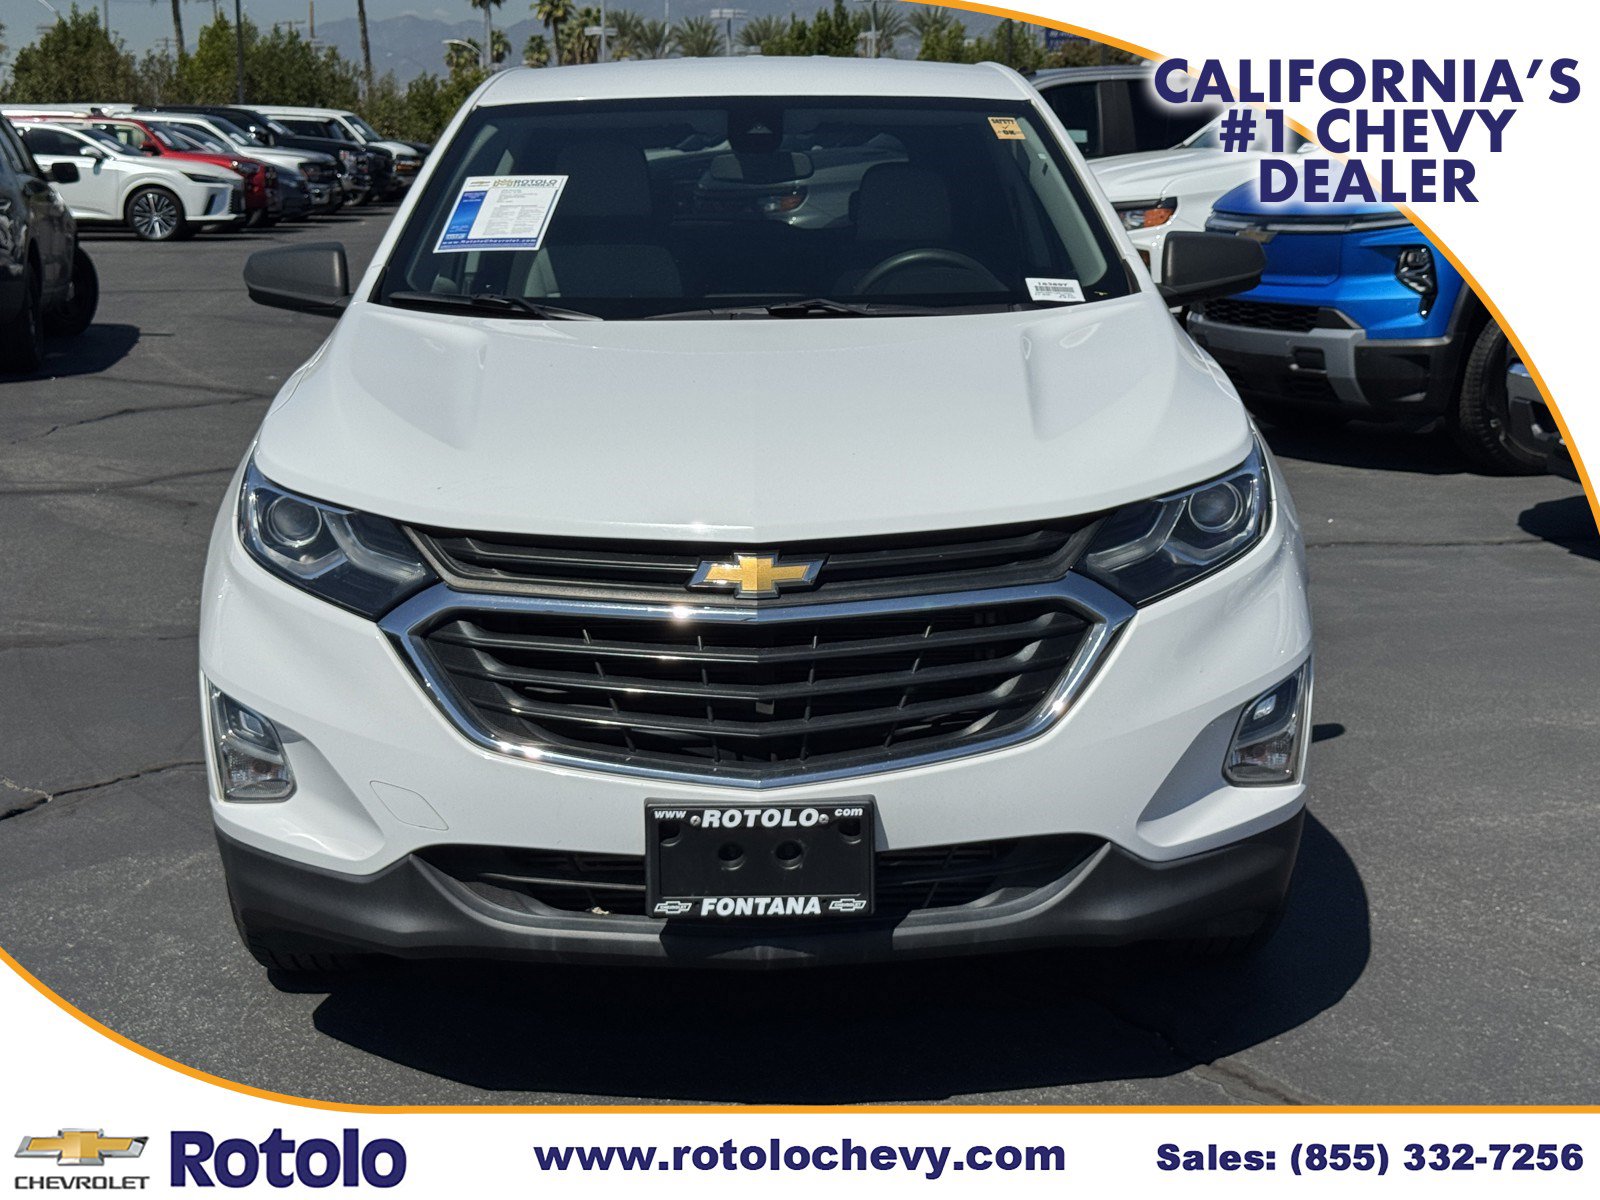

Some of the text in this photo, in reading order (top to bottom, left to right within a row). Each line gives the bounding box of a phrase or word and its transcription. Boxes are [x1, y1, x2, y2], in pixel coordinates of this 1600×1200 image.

[654, 807, 864, 829] www ROTOLO com
[700, 896, 822, 916] FONTANA
